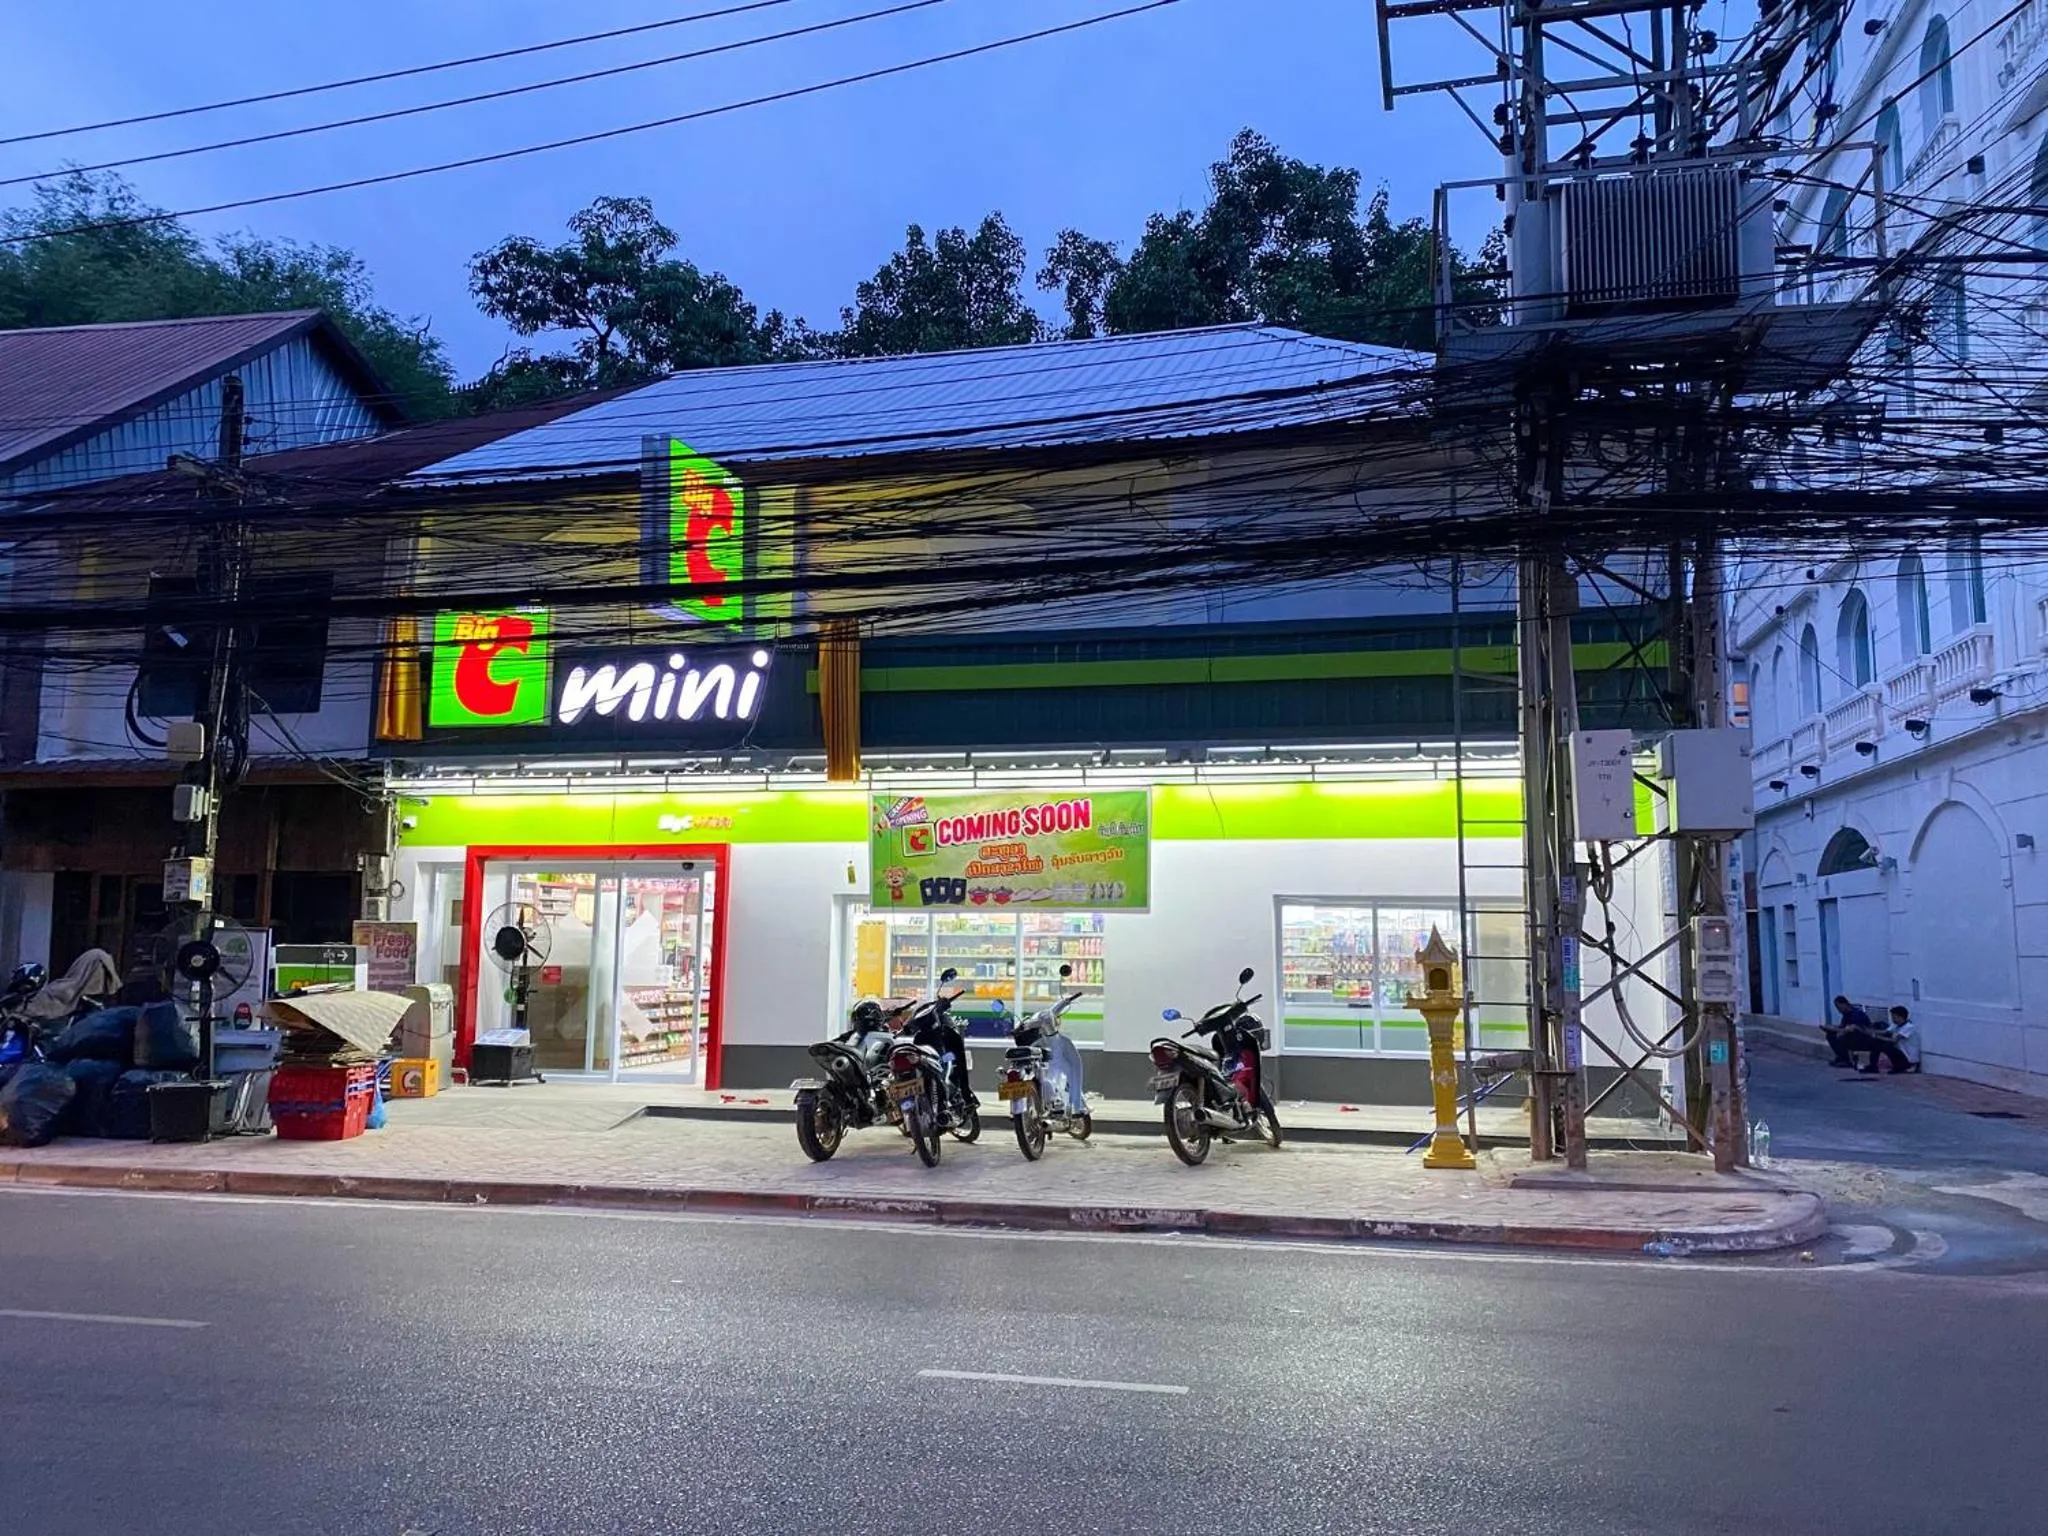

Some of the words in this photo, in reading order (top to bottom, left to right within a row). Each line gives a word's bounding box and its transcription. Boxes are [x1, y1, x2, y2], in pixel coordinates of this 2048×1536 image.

[453, 616, 500, 651] Big
[454, 615, 535, 717] C
[558, 650, 769, 724] mini
[938, 811, 1021, 845] COMING
[1022, 799, 1092, 833] SOON
[373, 933, 412, 947] Fresh
[376, 945, 410, 959] Food
